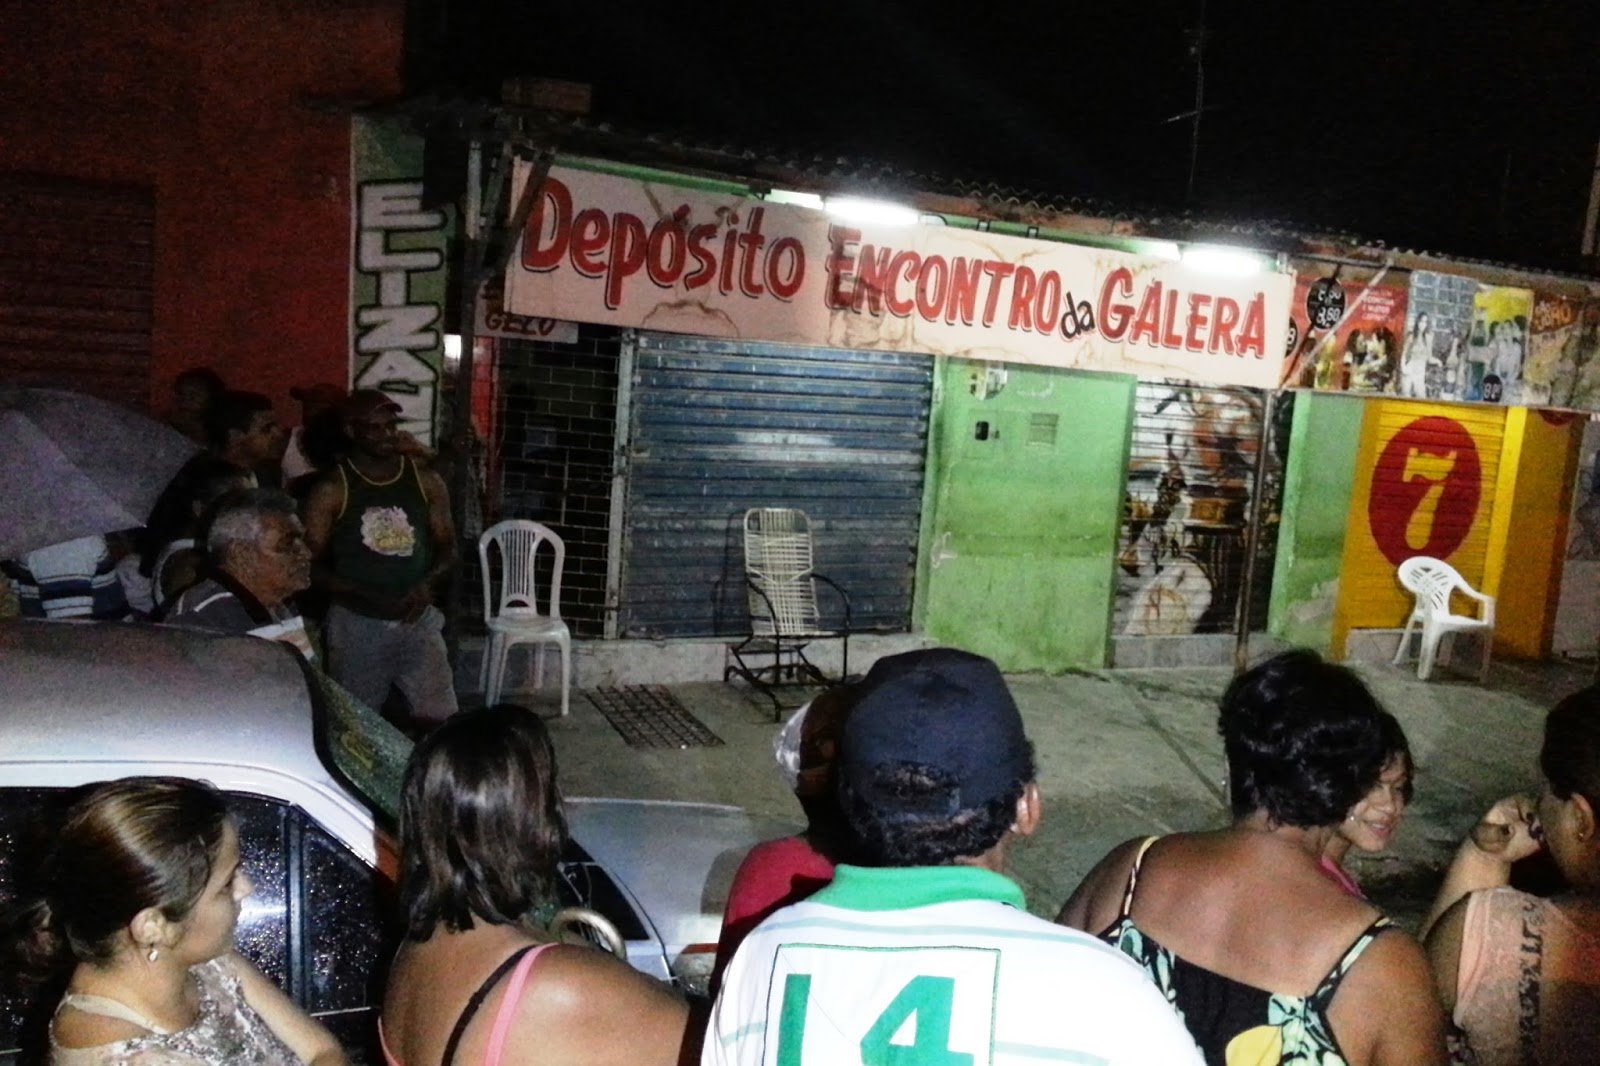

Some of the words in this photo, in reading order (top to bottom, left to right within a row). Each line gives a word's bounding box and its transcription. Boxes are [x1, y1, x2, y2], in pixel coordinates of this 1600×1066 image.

[521, 176, 806, 309] Depósito
[825, 223, 1061, 335] ENCONTRO
[1060, 291, 1096, 341] da
[1097, 267, 1266, 359] GALERA
[1402, 447, 1457, 550] 7
[777, 973, 974, 1066] 14
